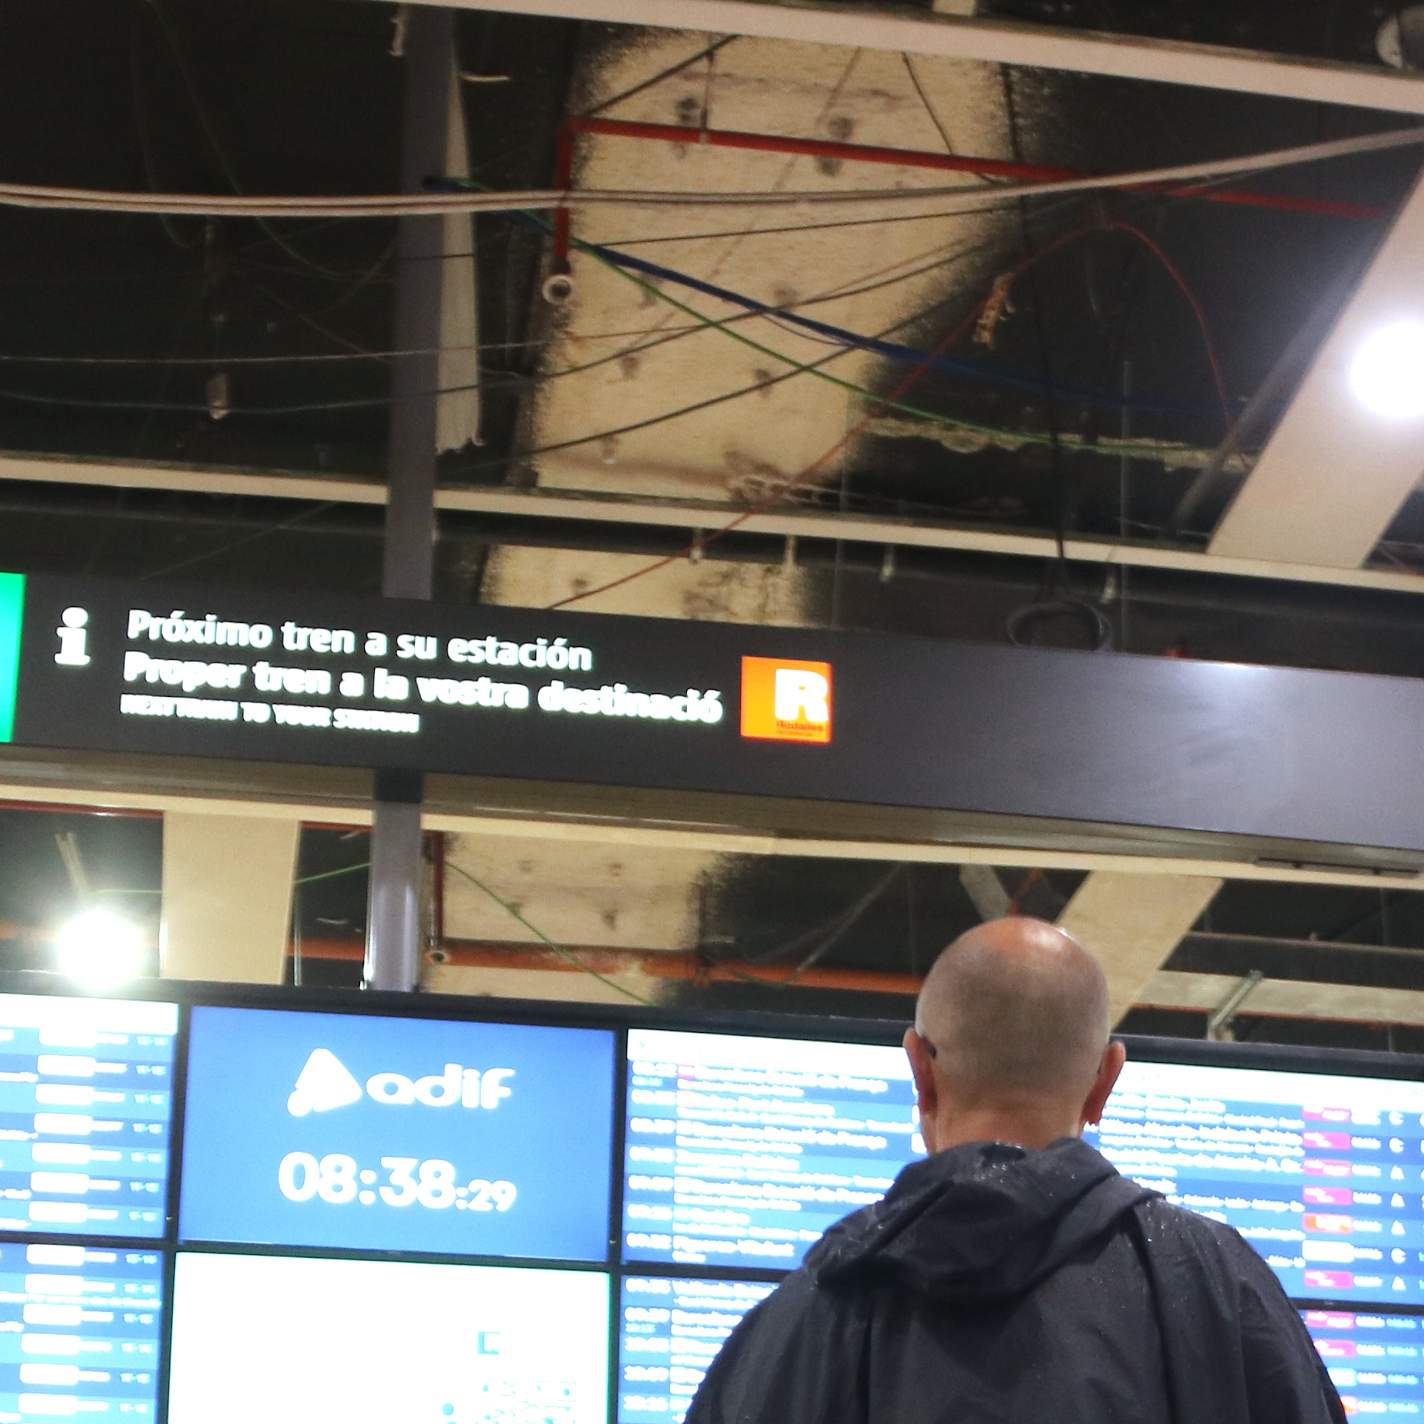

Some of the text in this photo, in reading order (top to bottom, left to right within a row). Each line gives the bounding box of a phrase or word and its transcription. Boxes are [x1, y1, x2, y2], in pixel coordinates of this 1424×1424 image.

[127, 609, 593, 671] Próximo tren a su estación
[124, 651, 723, 724] Proper tren a la vostra destinació
[775, 667, 829, 723] R
[365, 1062, 517, 1110] adif
[277, 1151, 517, 1212] 08:38:29
